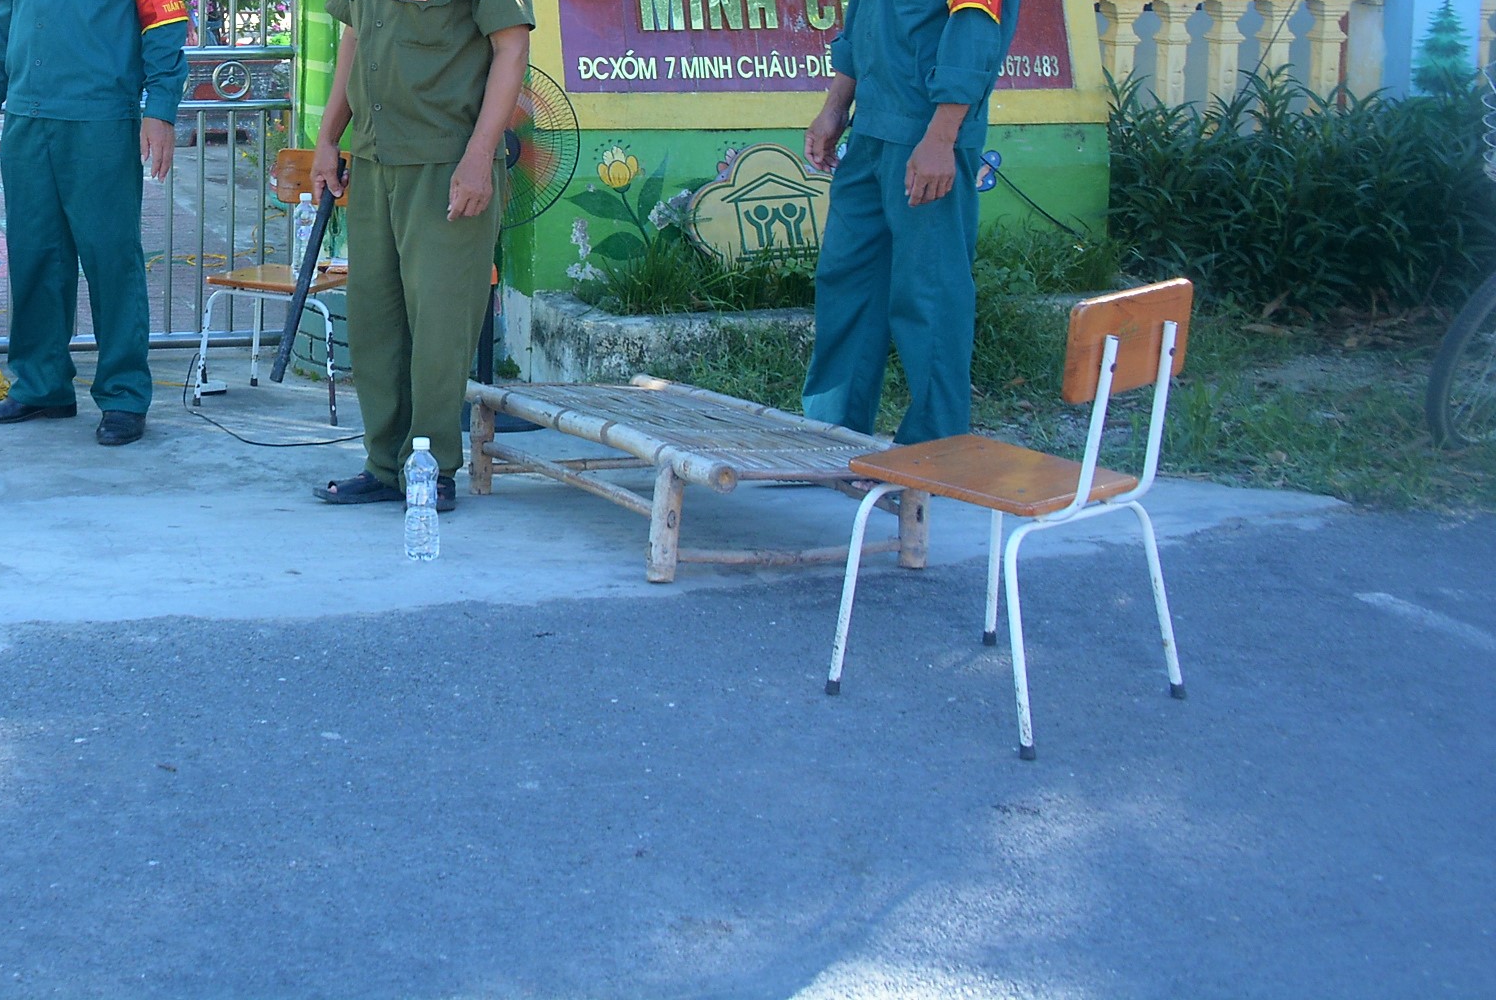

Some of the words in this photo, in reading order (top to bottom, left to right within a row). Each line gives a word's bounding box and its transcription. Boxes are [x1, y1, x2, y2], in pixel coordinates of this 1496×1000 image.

[664, 56, 676, 79] 7
[680, 57, 733, 79] MINH
[1033, 55, 1059, 77] 483
